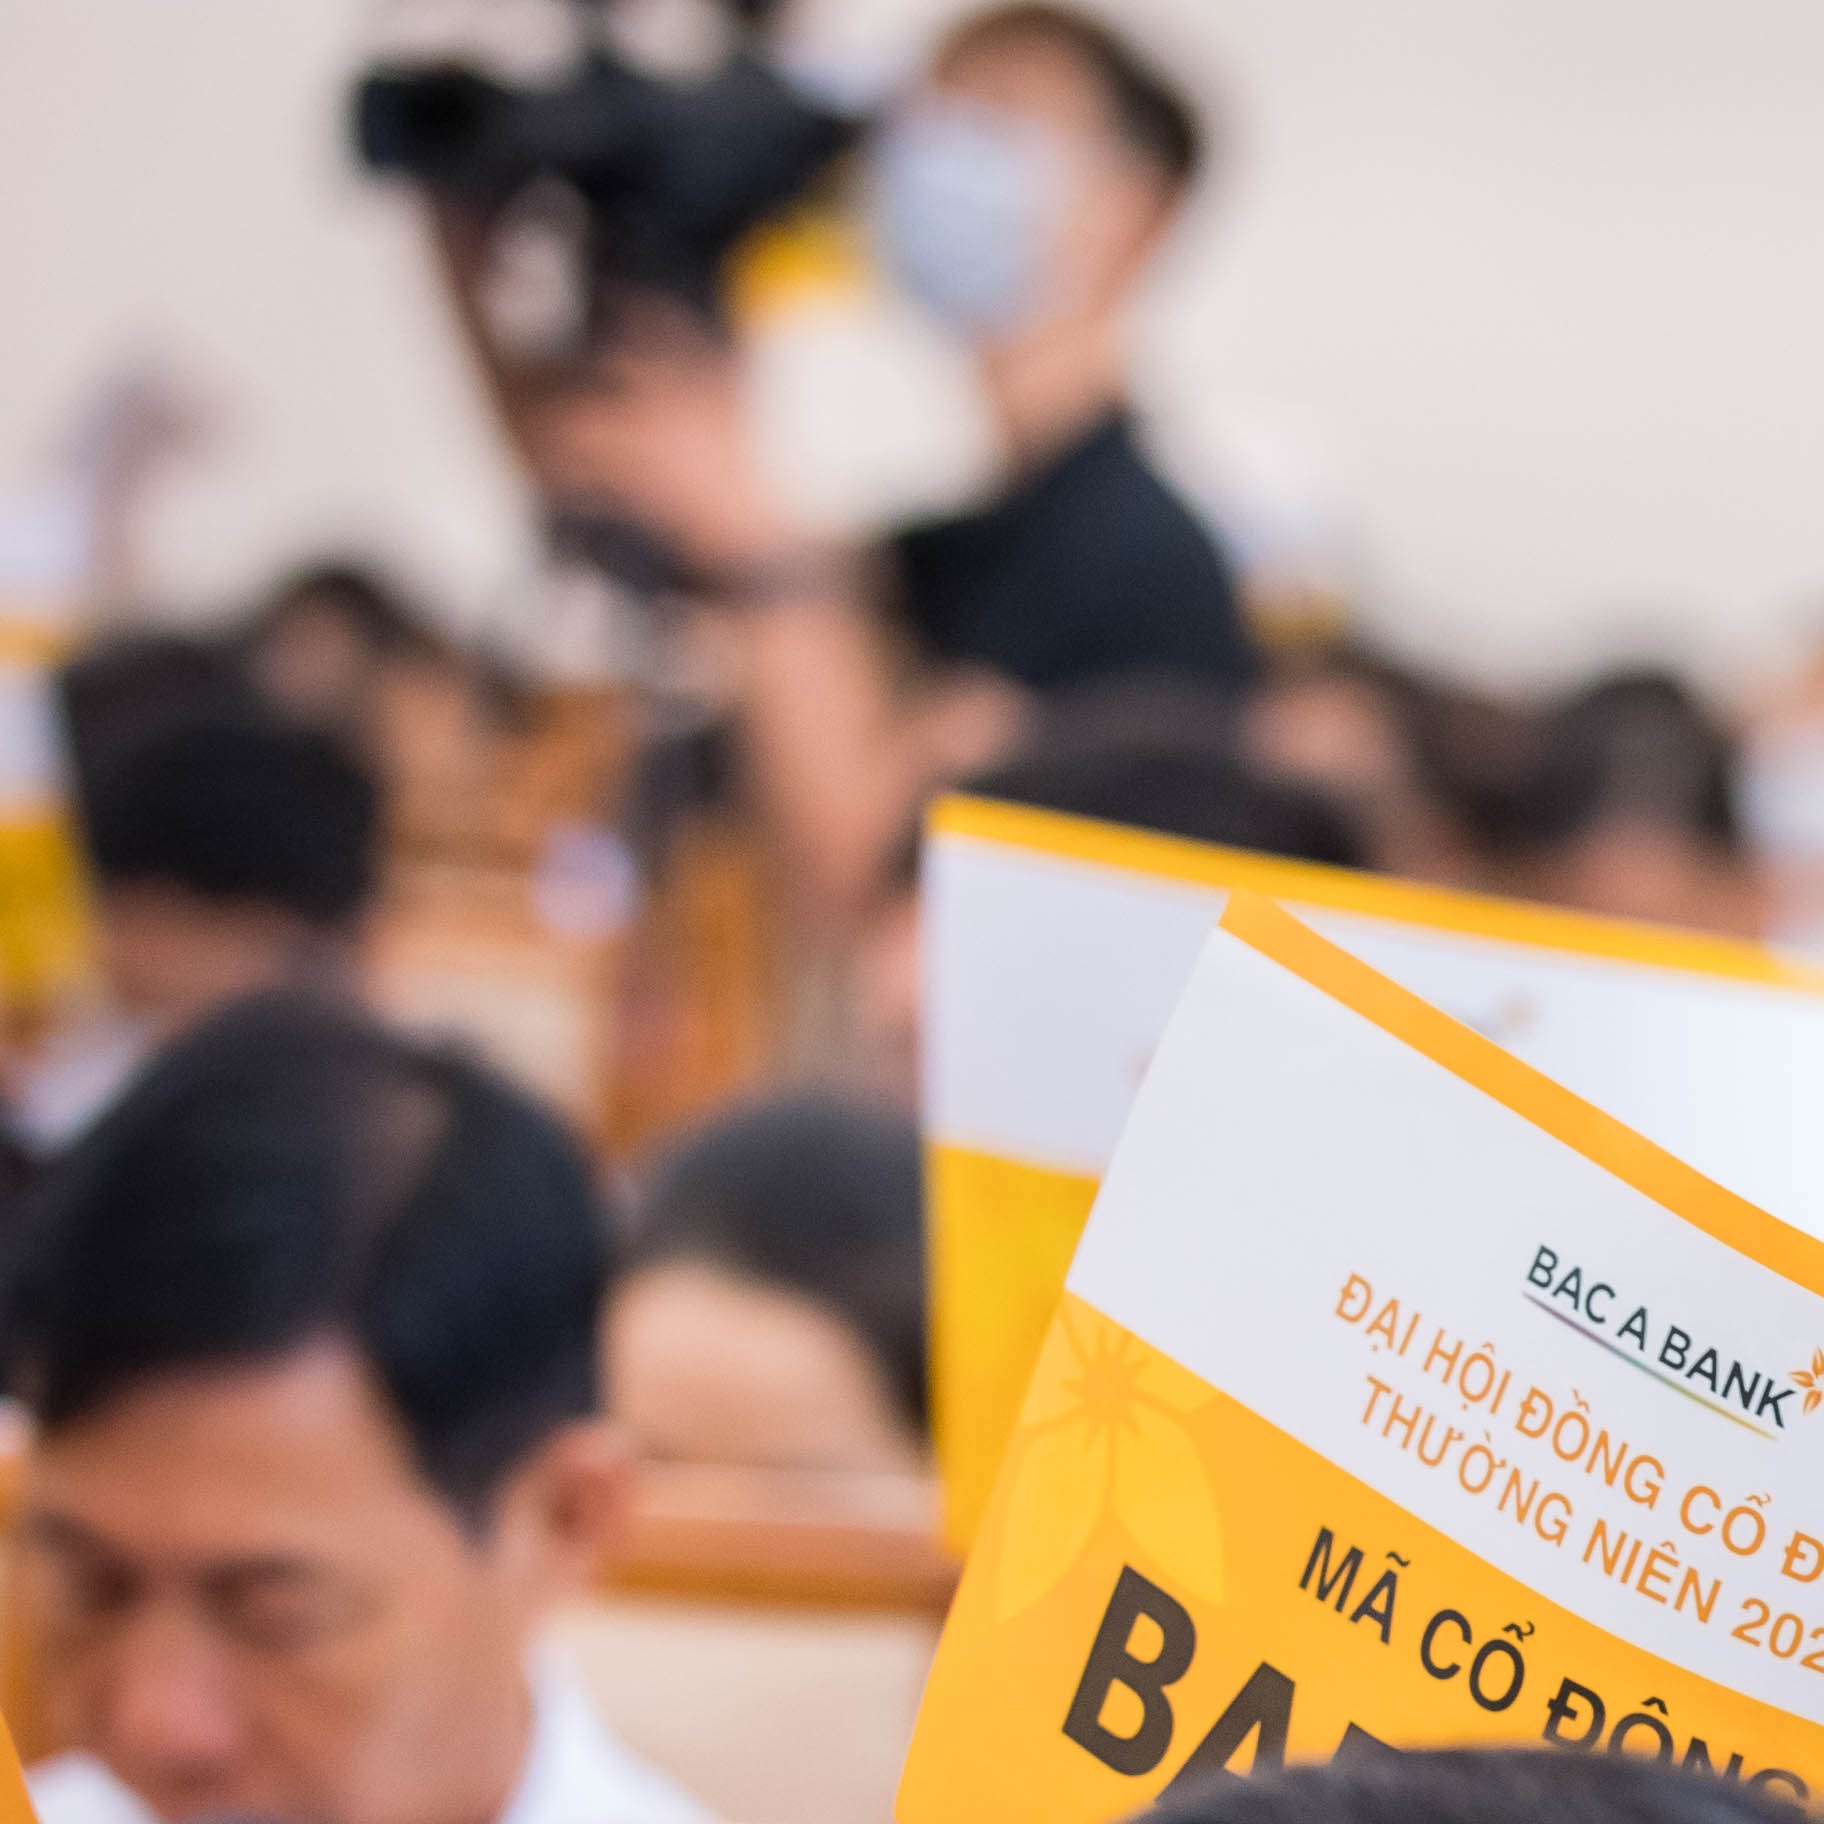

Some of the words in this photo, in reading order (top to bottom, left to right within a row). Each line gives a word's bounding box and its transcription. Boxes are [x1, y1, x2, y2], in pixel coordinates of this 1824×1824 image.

[1335, 1273, 1421, 1357] ĐẠI
[1423, 1328, 1511, 1414] HỘI
[1515, 1387, 1665, 1509] ĐỒNG
[1679, 1485, 1771, 1556] CỔ
[1526, 1245, 1616, 1324] BAC
[1616, 1306, 1648, 1351] A
[1658, 1325, 1796, 1429] BANK
[1361, 1374, 1573, 1547] THƯỜNG
[1583, 1518, 1722, 1623] NIÊN
[1299, 1525, 1410, 1645] MÃ
[1420, 1609, 1535, 1712] CỔ
